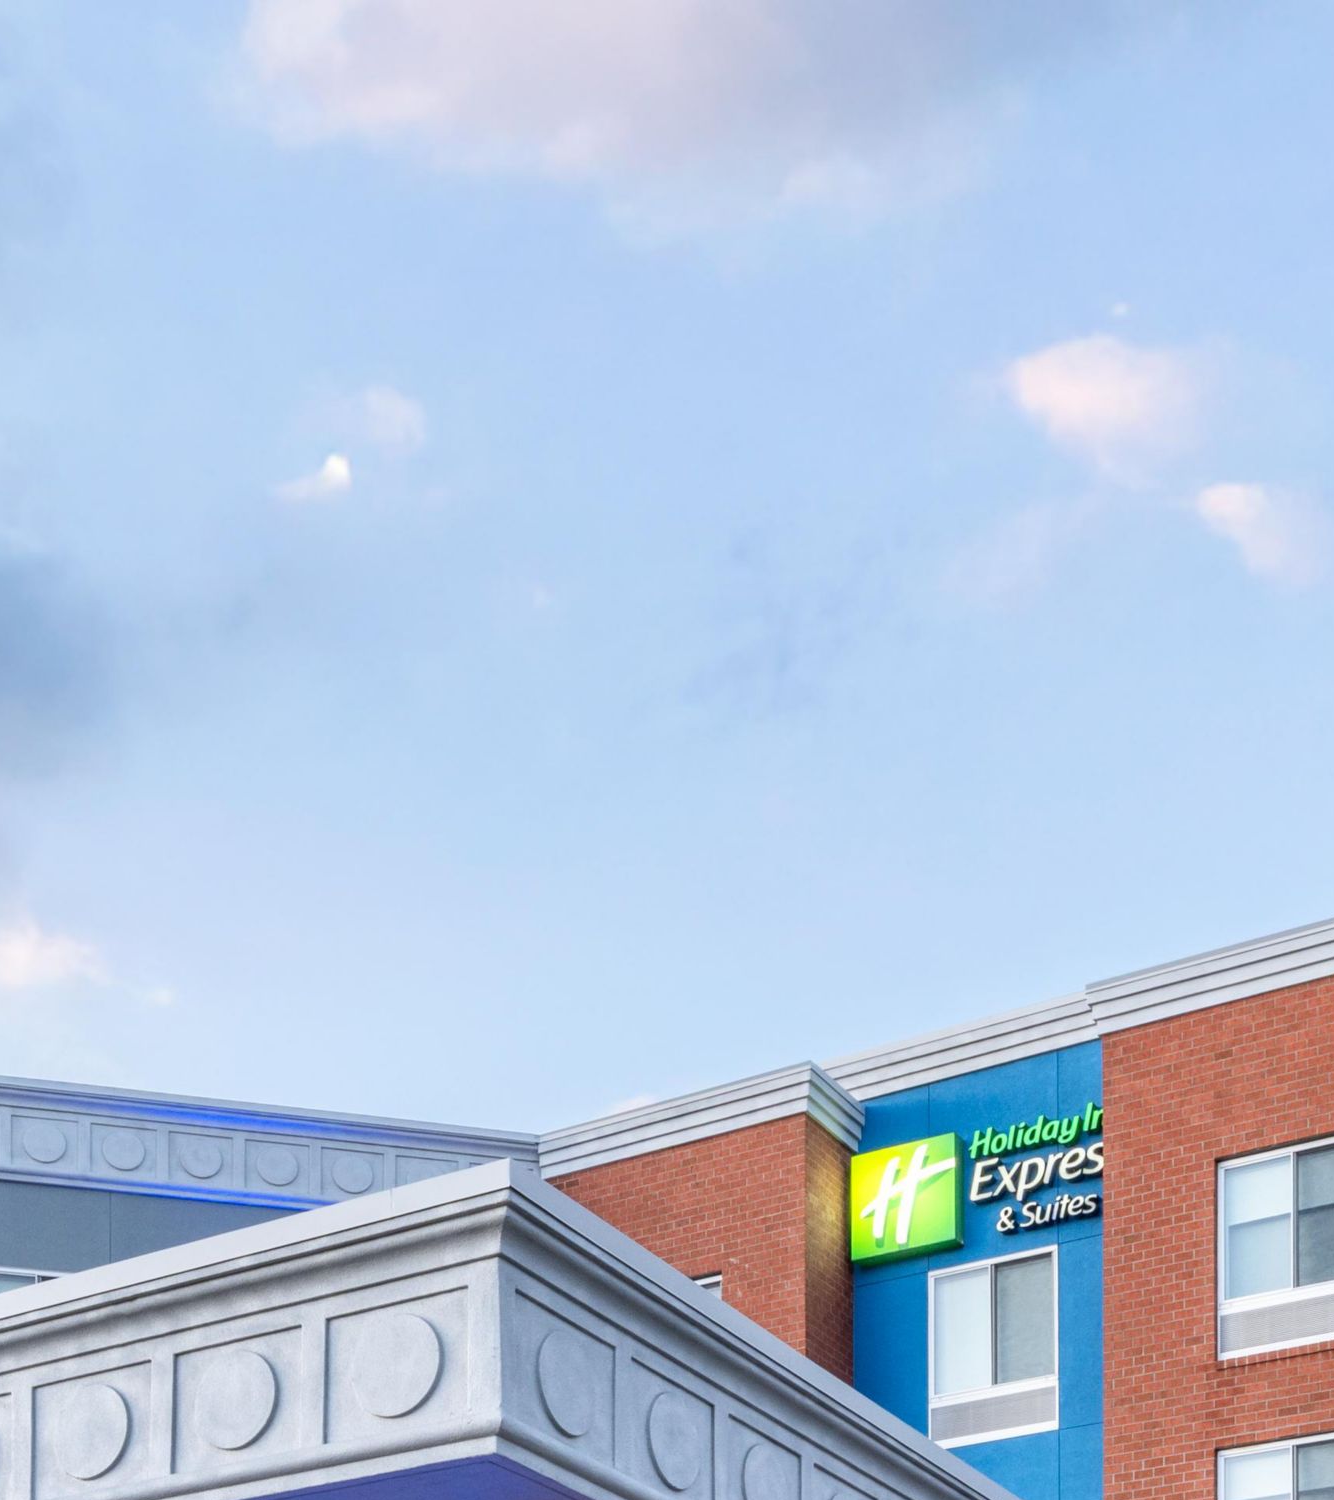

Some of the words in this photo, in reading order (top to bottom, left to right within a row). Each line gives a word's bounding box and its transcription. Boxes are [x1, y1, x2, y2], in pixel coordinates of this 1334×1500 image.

[969, 1114, 1080, 1159] Holiday
[969, 1141, 1104, 1202] Expres
[996, 1206, 1015, 1232] &
[1020, 1193, 1097, 1228] Suites
